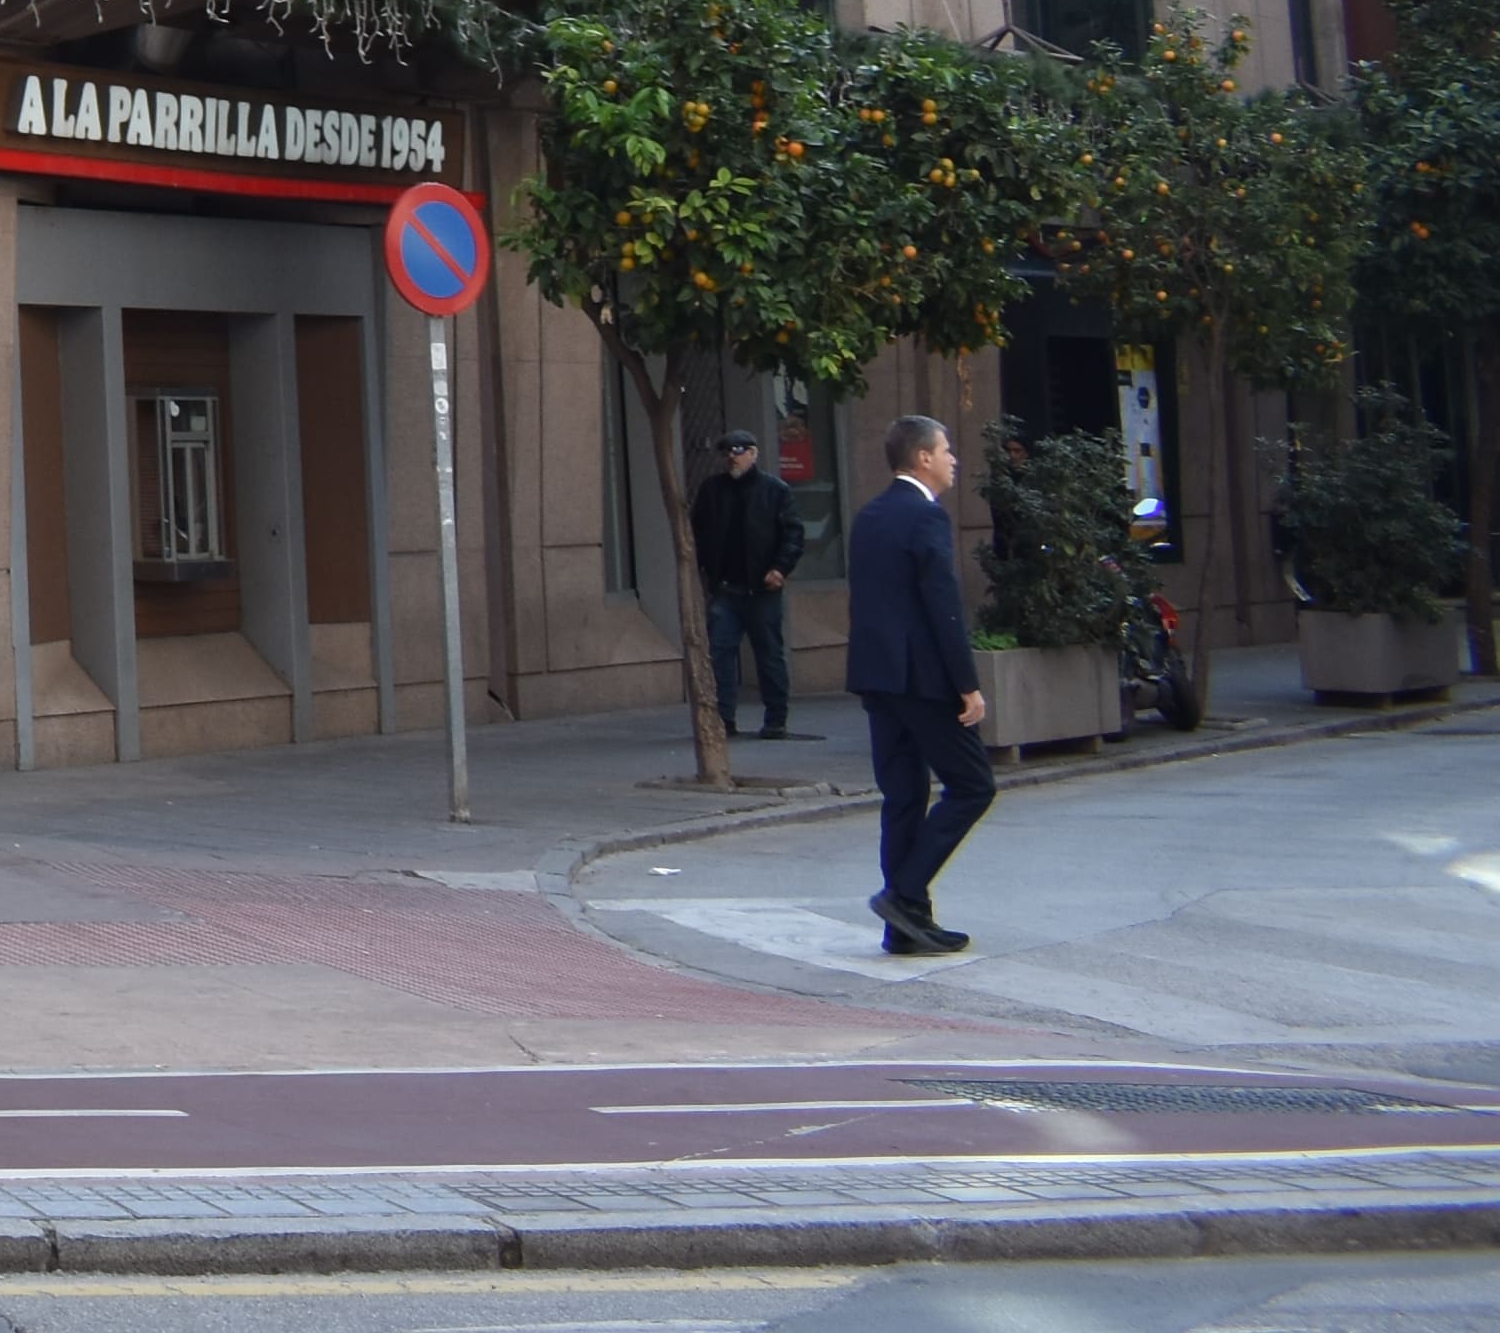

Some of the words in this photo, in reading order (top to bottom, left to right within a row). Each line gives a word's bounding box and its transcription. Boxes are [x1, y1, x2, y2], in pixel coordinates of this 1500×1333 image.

[17, 75, 47, 134] A
[52, 78, 102, 141] LA
[107, 84, 279, 160] PARRILLA
[284, 105, 376, 168] DESDE
[382, 114, 445, 173] 1954
